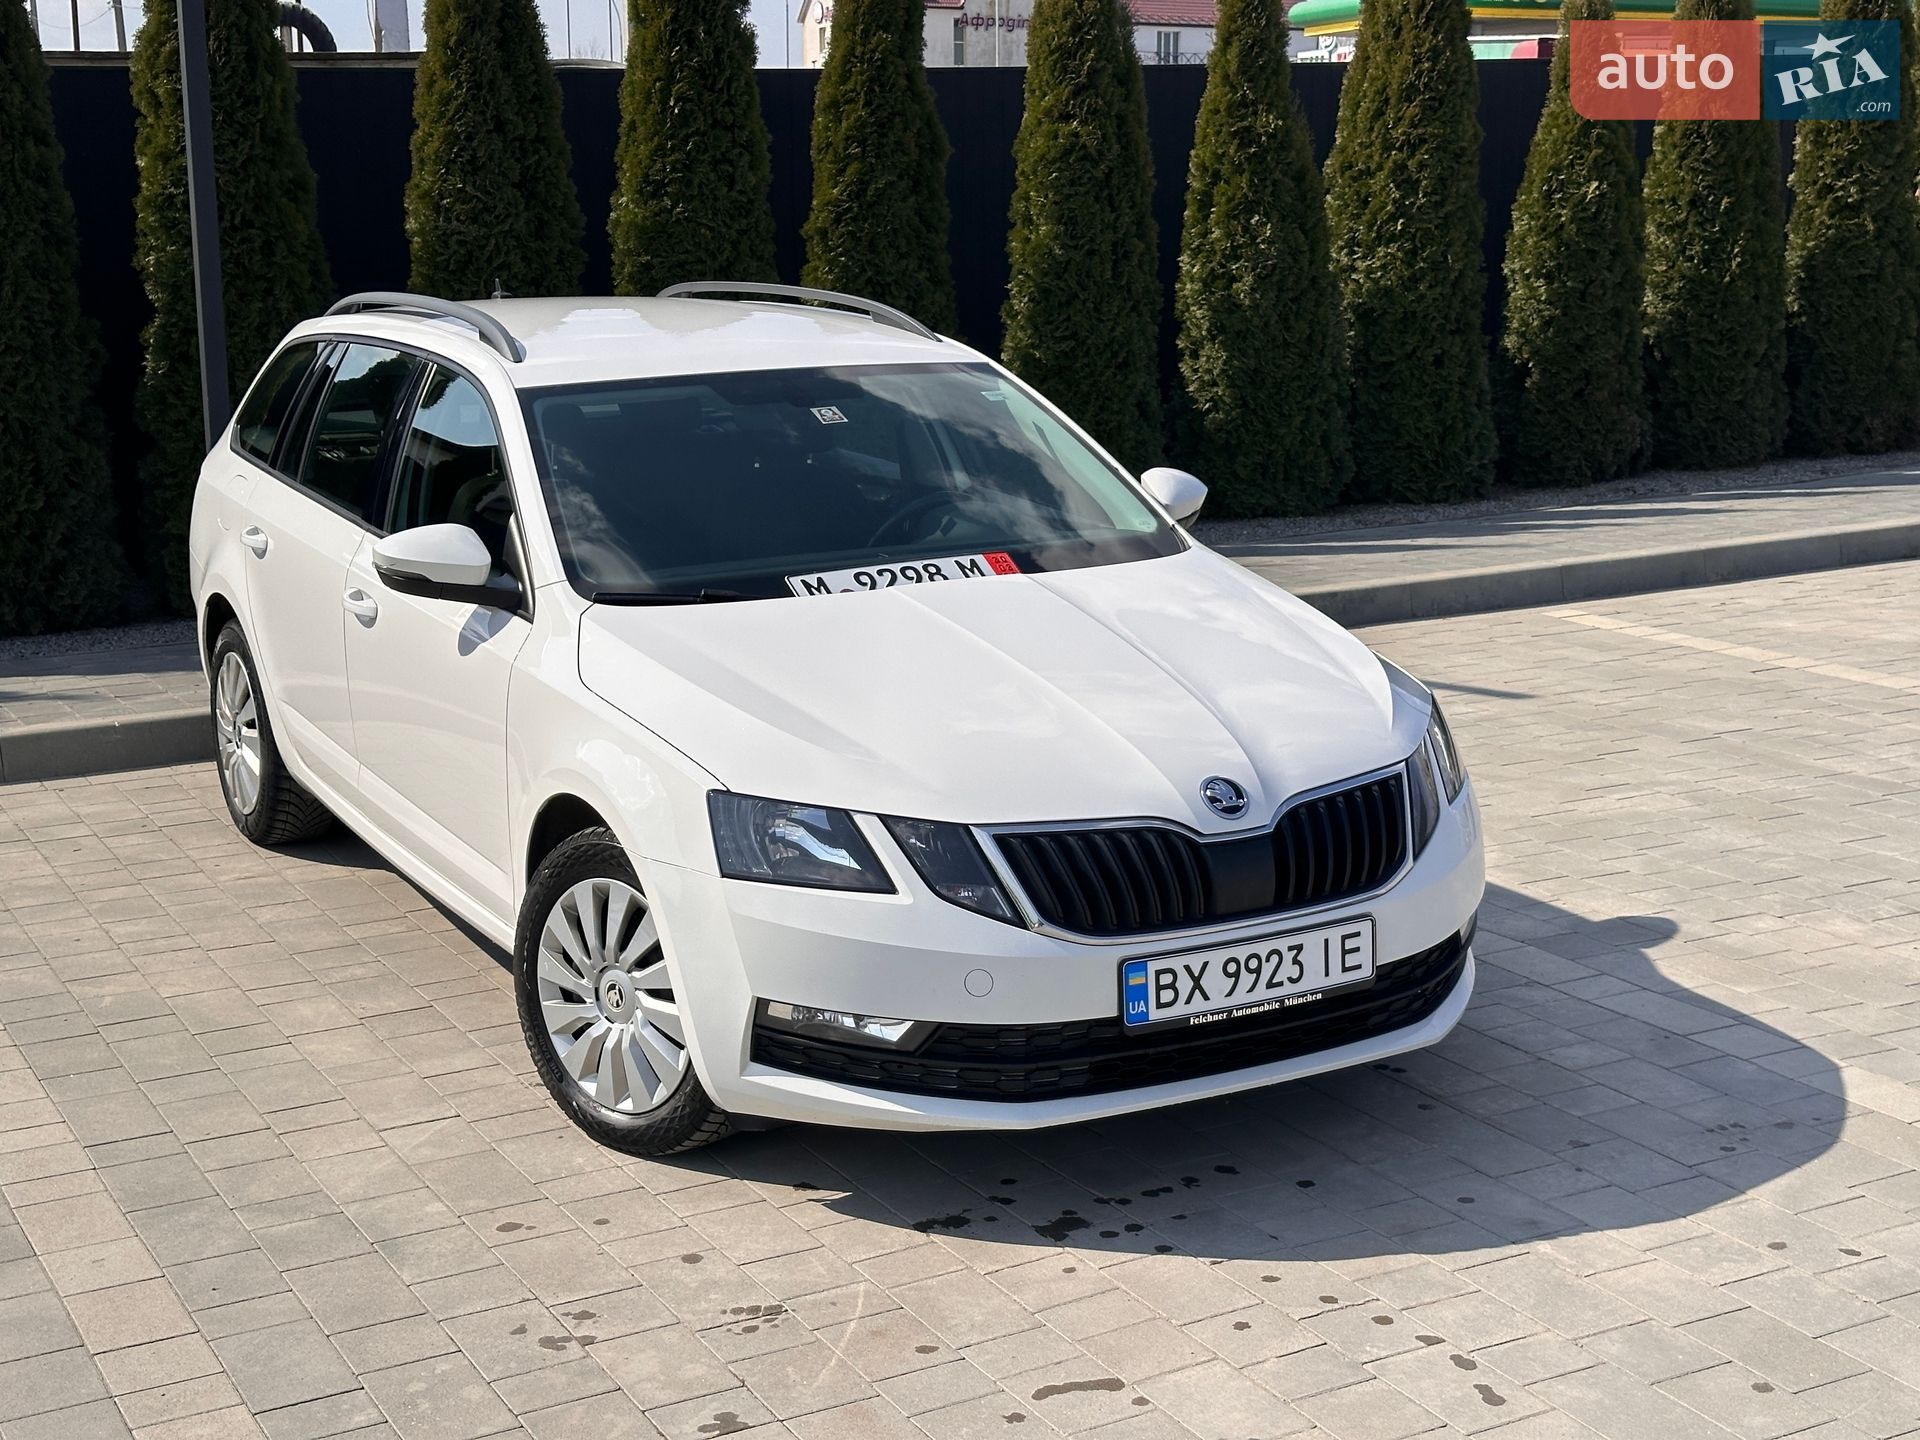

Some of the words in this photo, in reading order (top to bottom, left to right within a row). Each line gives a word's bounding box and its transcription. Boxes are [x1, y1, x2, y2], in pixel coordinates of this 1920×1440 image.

[800, 576, 832, 596] M
[852, 563, 949, 591] 9298
[953, 558, 986, 578] M
[1154, 960, 1210, 1010] BX
[1221, 943, 1304, 998] 9923
[1323, 930, 1362, 978] IE
[1129, 1000, 1147, 1014] UA
[1190, 1012, 1228, 1025] Felchner
[1231, 1002, 1281, 1018] Automobile
[1284, 992, 1322, 1007] München
